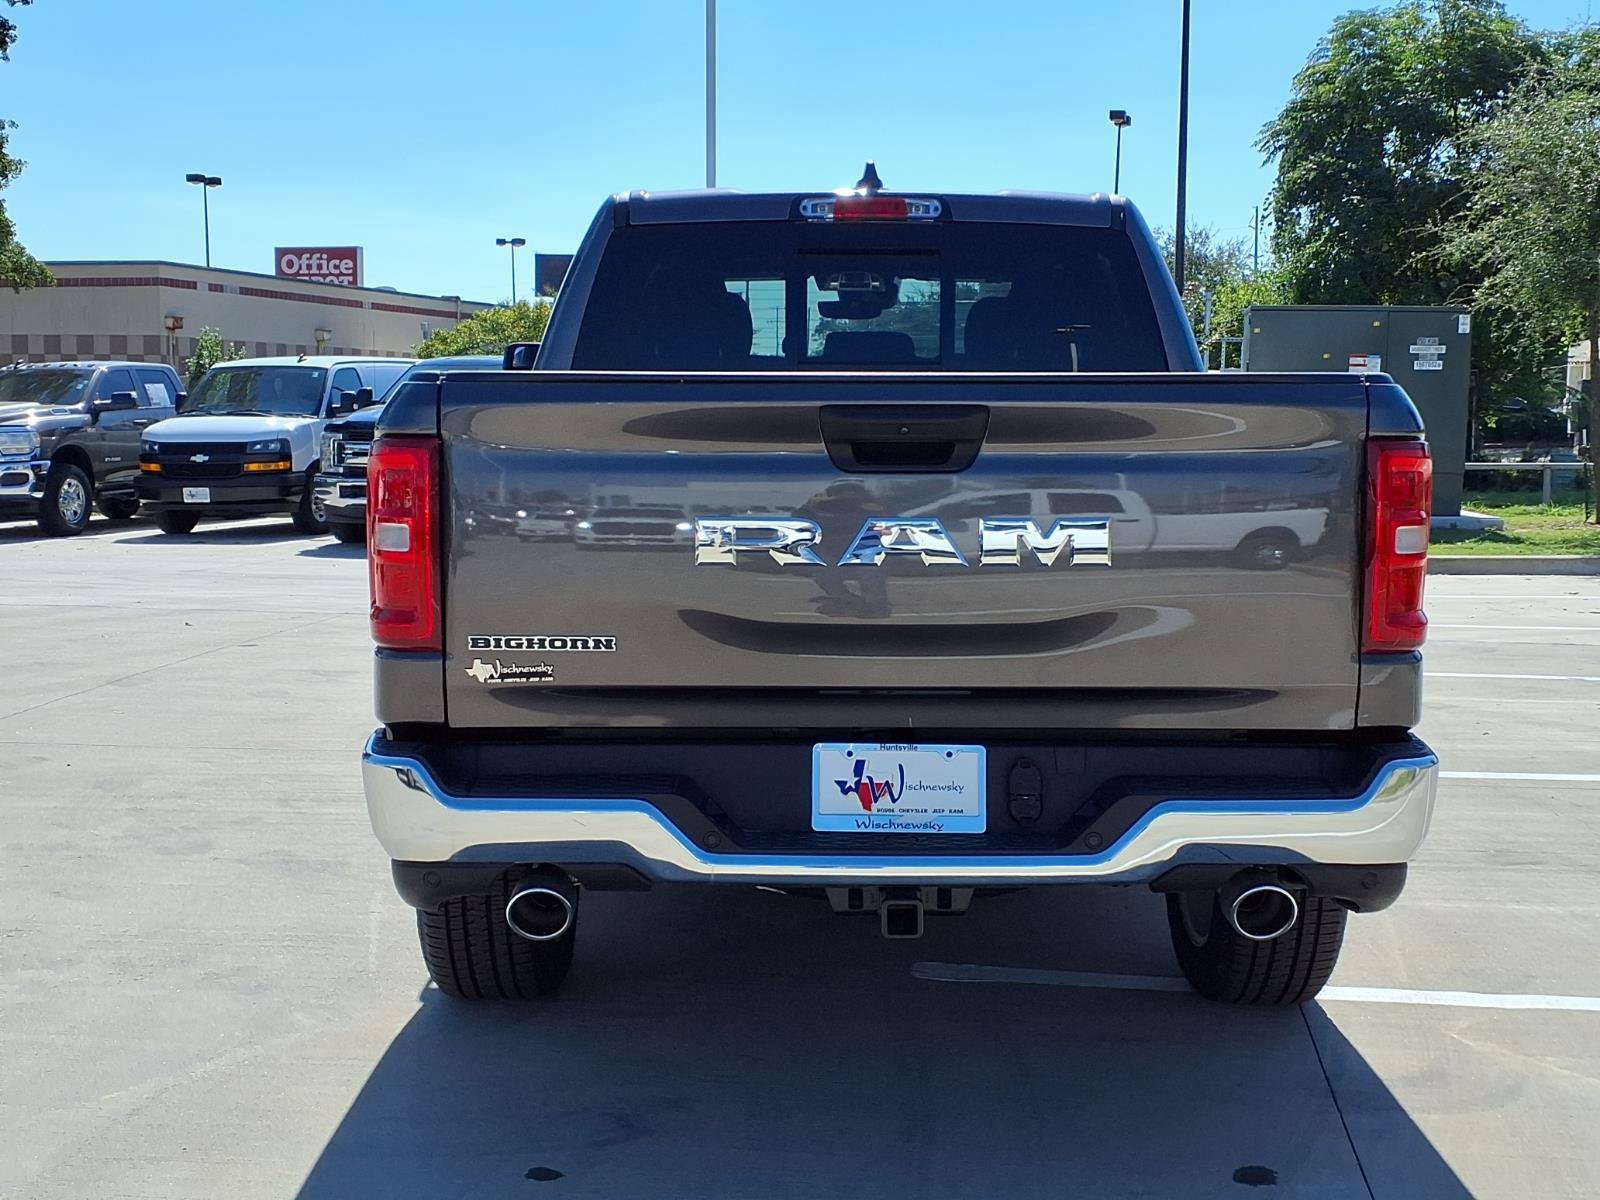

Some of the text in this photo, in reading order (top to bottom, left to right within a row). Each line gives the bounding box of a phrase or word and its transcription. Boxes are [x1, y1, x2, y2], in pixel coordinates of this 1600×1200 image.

[280, 253, 354, 274] Office
[694, 516, 1113, 567] RAM
[468, 635, 617, 652] BIGHORN
[880, 743, 919, 751] Huntsville
[866, 763, 965, 804] Wischnewsky
[855, 815, 944, 832] Wischnewsky
